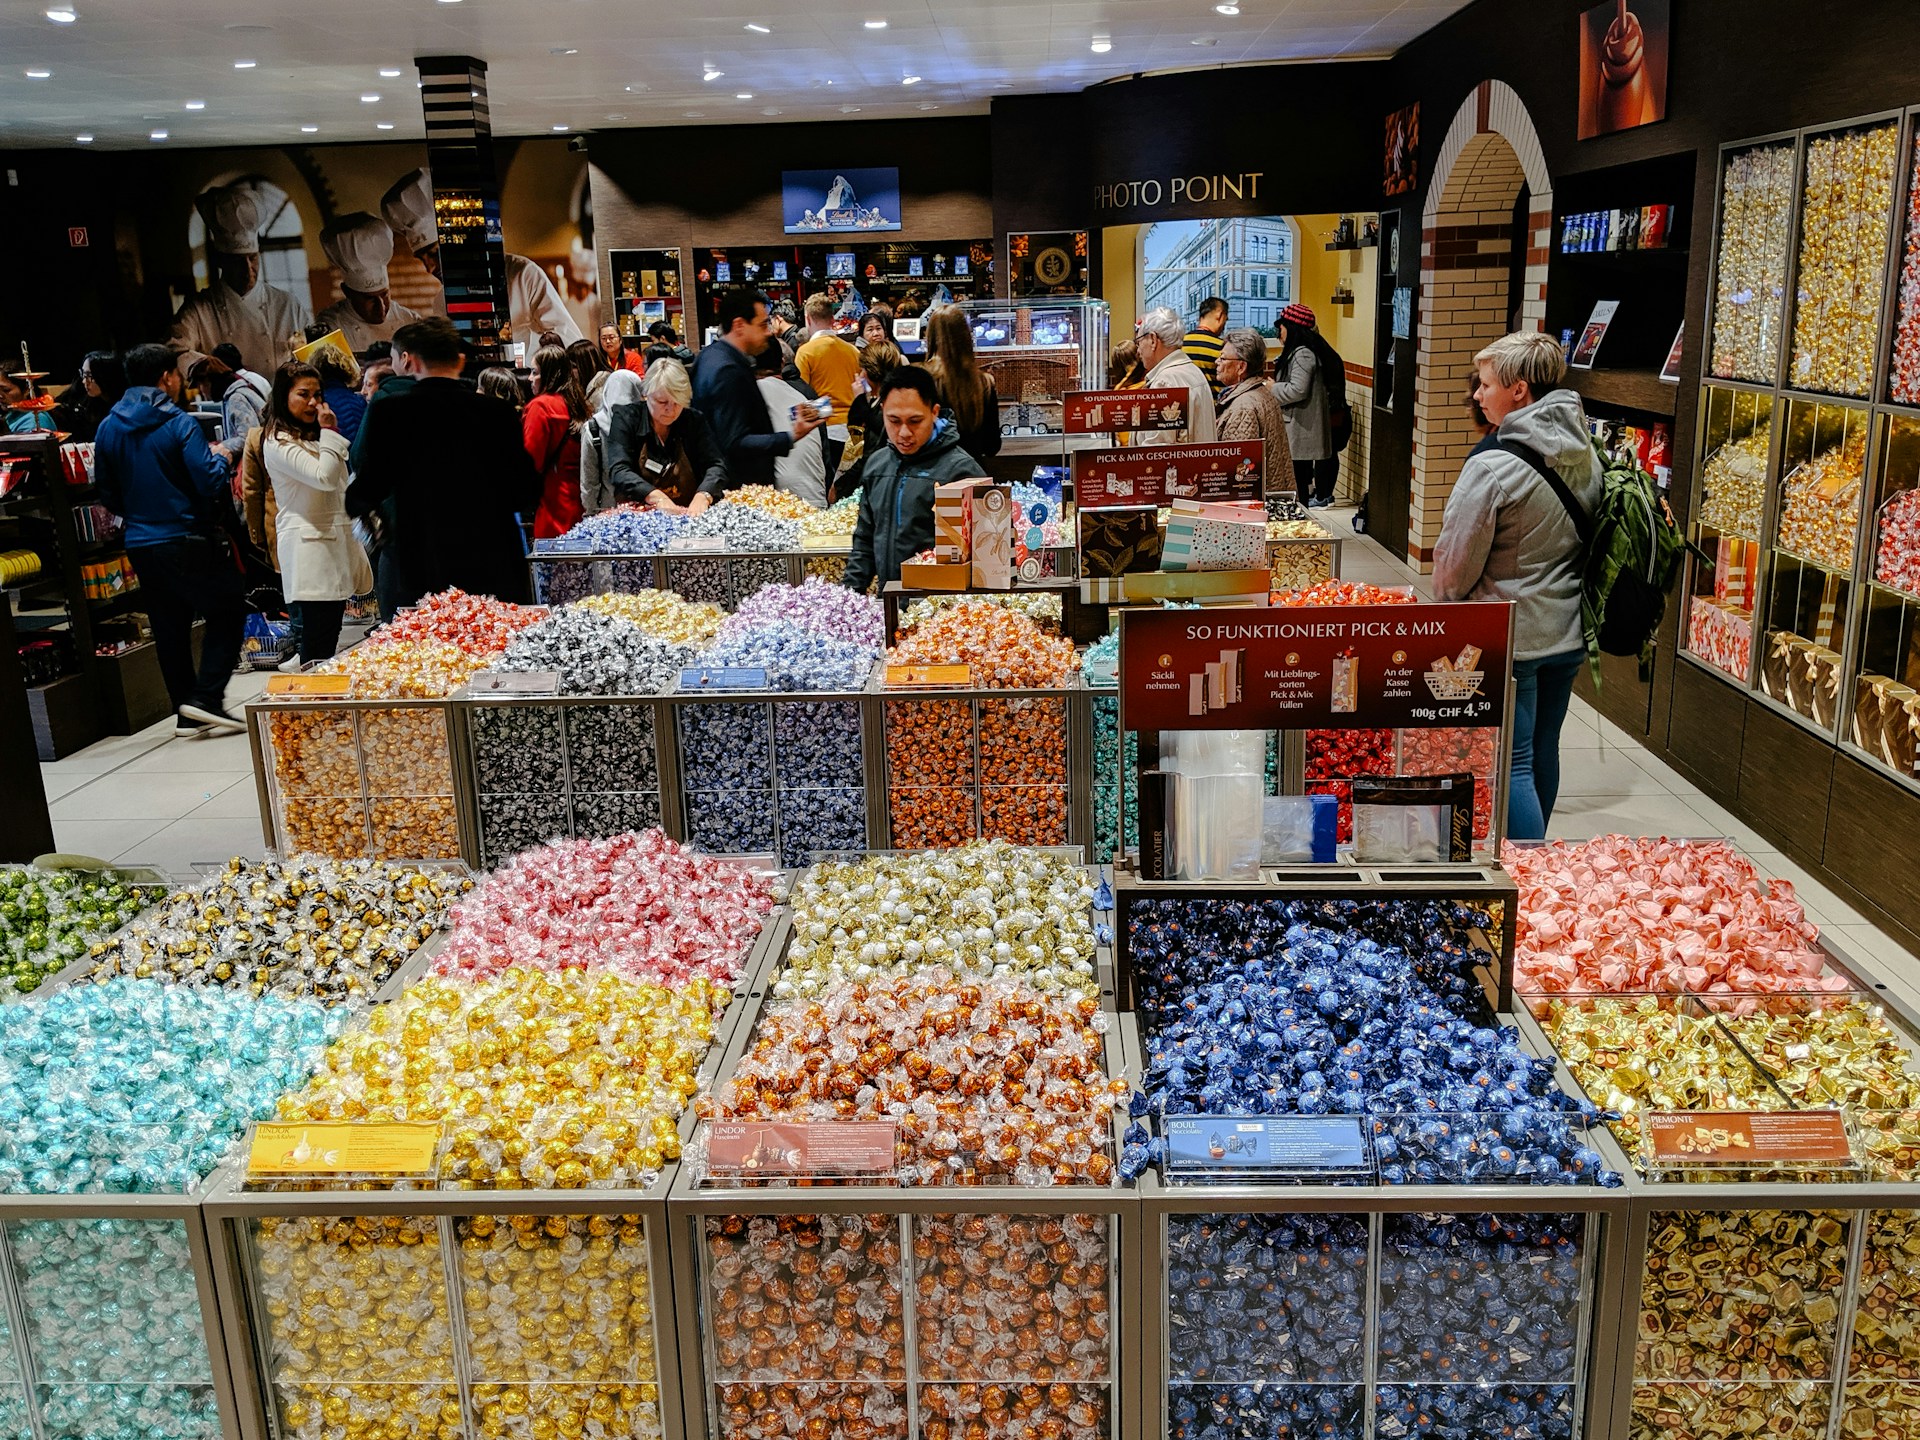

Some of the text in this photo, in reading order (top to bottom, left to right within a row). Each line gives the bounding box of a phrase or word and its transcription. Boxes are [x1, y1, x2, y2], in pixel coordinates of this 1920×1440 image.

[1094, 172, 1264, 209] PHOTO POINT
[1094, 394, 1136, 402] FUNKTIONIERT
[1096, 447, 1242, 463] PICK & MIX GESCHENKBOUTIQUE
[1186, 621, 1446, 640] SO FUNKTIONIERT PICK & MIX
[1162, 657, 1171, 666] 1.
[1289, 655, 1298, 664] 2.
[1396, 653, 1405, 662] 3.
[1151, 671, 1175, 680] Säckli
[1264, 669, 1321, 680] Mit Lieblings-
[1383, 668, 1414, 677] An der
[1145, 682, 1181, 690] nehmen
[1278, 681, 1306, 689] sorten
[1386, 679, 1410, 687] Kasse
[1270, 690, 1314, 699] Pick & Mix
[1383, 688, 1412, 697] zahlen
[1279, 700, 1304, 709] füllen
[1410, 702, 1491, 720] 100g CHF 4.50
[1452, 804, 1470, 851] Lindt
[1650, 1115, 1694, 1124] PIEMONTE
[1171, 1121, 1196, 1129] BOULE
[714, 1126, 746, 1135] LINDOR
